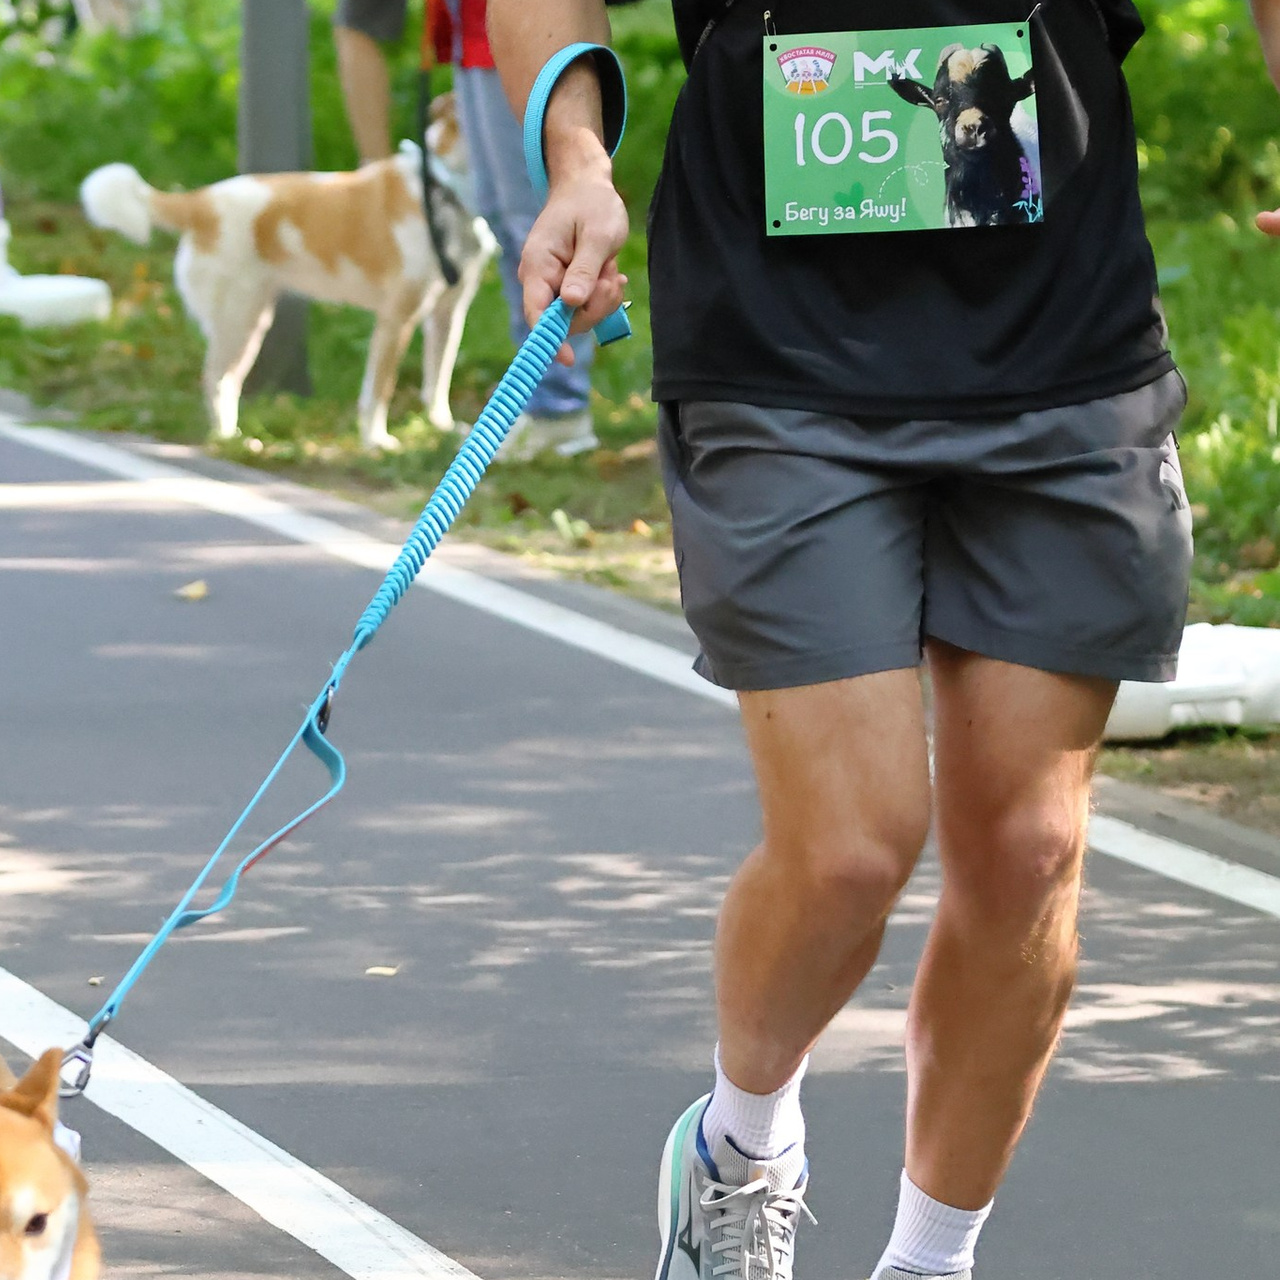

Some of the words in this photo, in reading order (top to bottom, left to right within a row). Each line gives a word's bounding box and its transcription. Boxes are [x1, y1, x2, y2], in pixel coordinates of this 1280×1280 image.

[778, 49, 815, 63] ХВОСТАТАЯ
[815, 50, 836, 61] МИЛЯ
[794, 110, 899, 167] 105
[785, 201, 829, 226] Бегу
[833, 206, 856, 220] за
[859, 197, 907, 224] Яшу!
